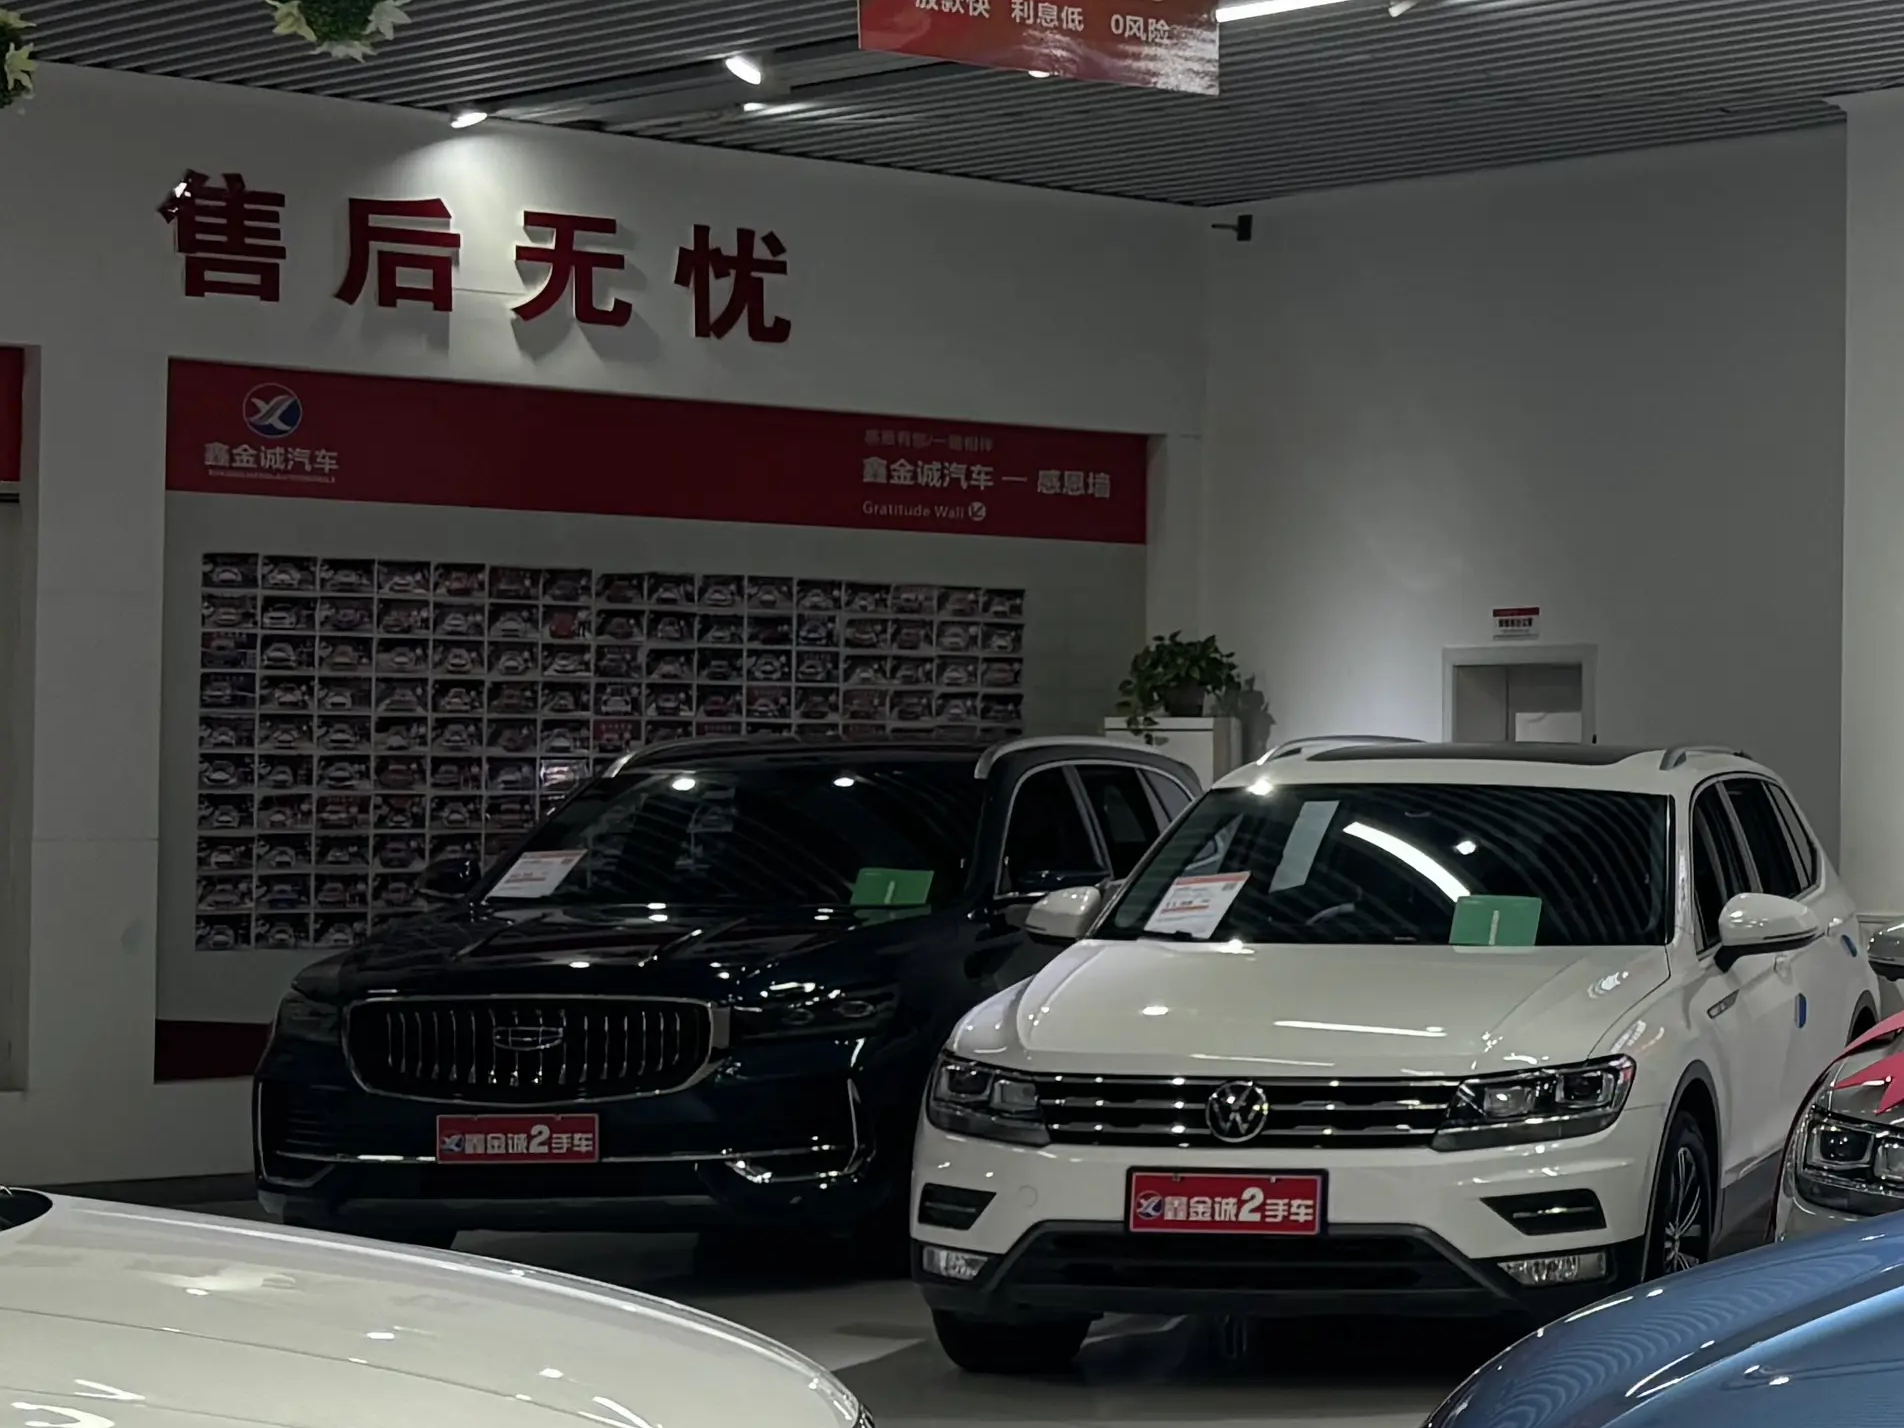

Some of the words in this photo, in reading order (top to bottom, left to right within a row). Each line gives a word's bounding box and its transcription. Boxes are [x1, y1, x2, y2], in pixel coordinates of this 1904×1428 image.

[1110, 13, 1170, 43] 0风险
[155, 169, 794, 345] 售后无忧
[204, 441, 339, 474] 鑫金诚汽车
[862, 456, 995, 491] 鑫金诚汽车
[1036, 469, 1112, 499] 感恩墙
[862, 501, 931, 518] Gratitude
[934, 504, 965, 520] Wall
[464, 1124, 593, 1154] 鑫金诚2手车
[1163, 1185, 1315, 1221] 鑫金诚2手车
